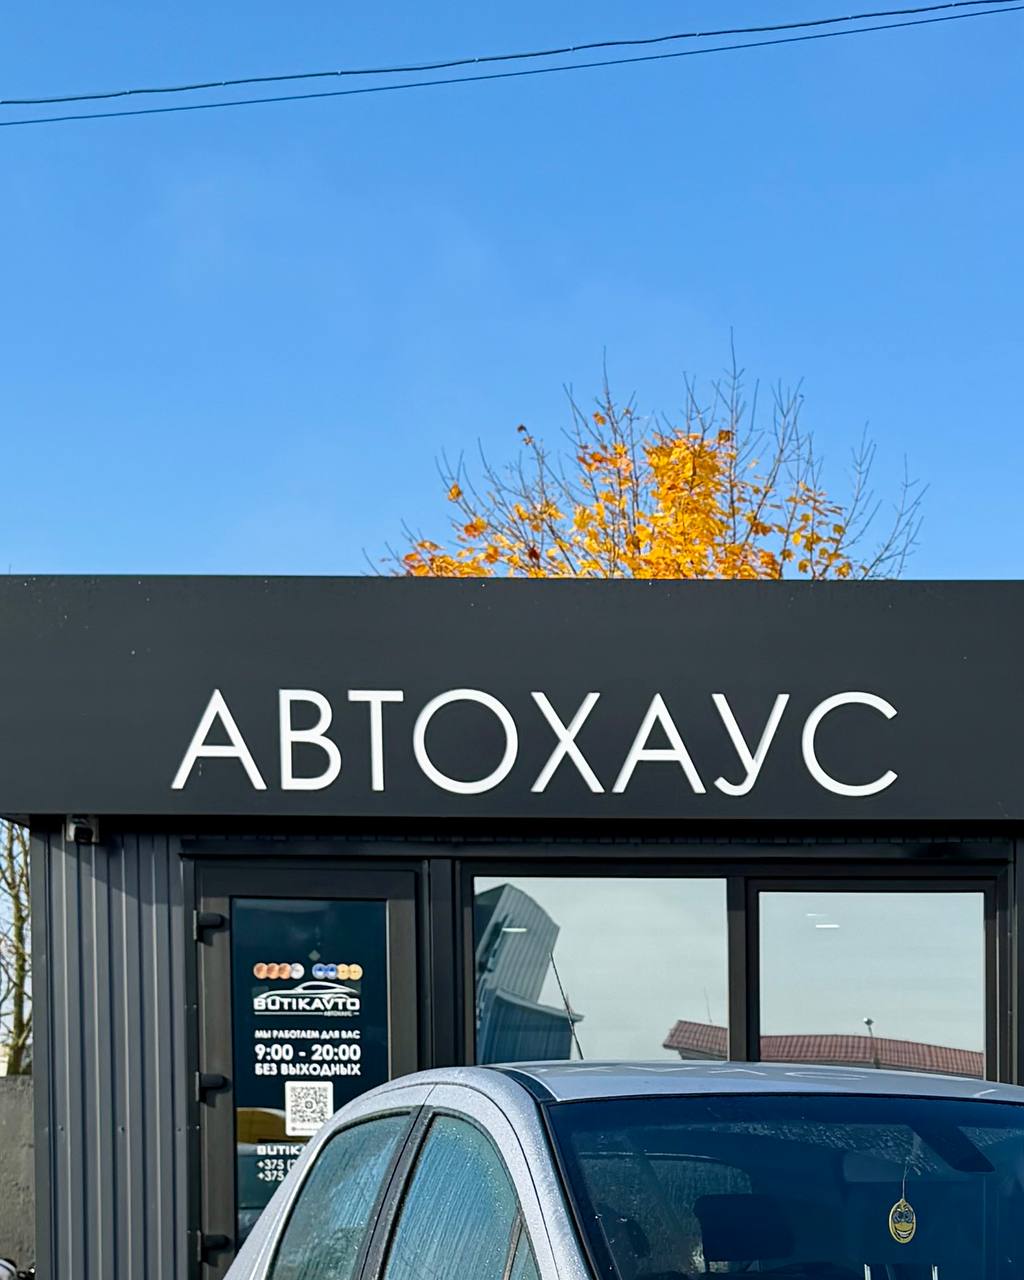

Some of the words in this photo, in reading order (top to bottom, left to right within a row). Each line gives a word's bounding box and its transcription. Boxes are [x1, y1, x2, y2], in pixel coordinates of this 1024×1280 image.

[170, 687, 899, 797] АВТОХАУС
[253, 997, 360, 1011] BUTIKAVTO
[254, 1030, 272, 1040] МЫ
[272, 1029, 320, 1040] РАБОТАЕМ
[320, 1029, 340, 1041] ДЛЯ
[340, 1029, 361, 1040] ВАС
[254, 1044, 294, 1061] 9:00
[310, 1044, 361, 1061] 20:00
[254, 1063, 278, 1076] БЕЗ
[280, 1063, 361, 1077] ВЫХОДНЫХ
[256, 1145, 304, 1156] BUTIK
[256, 1159, 285, 1170] +375
